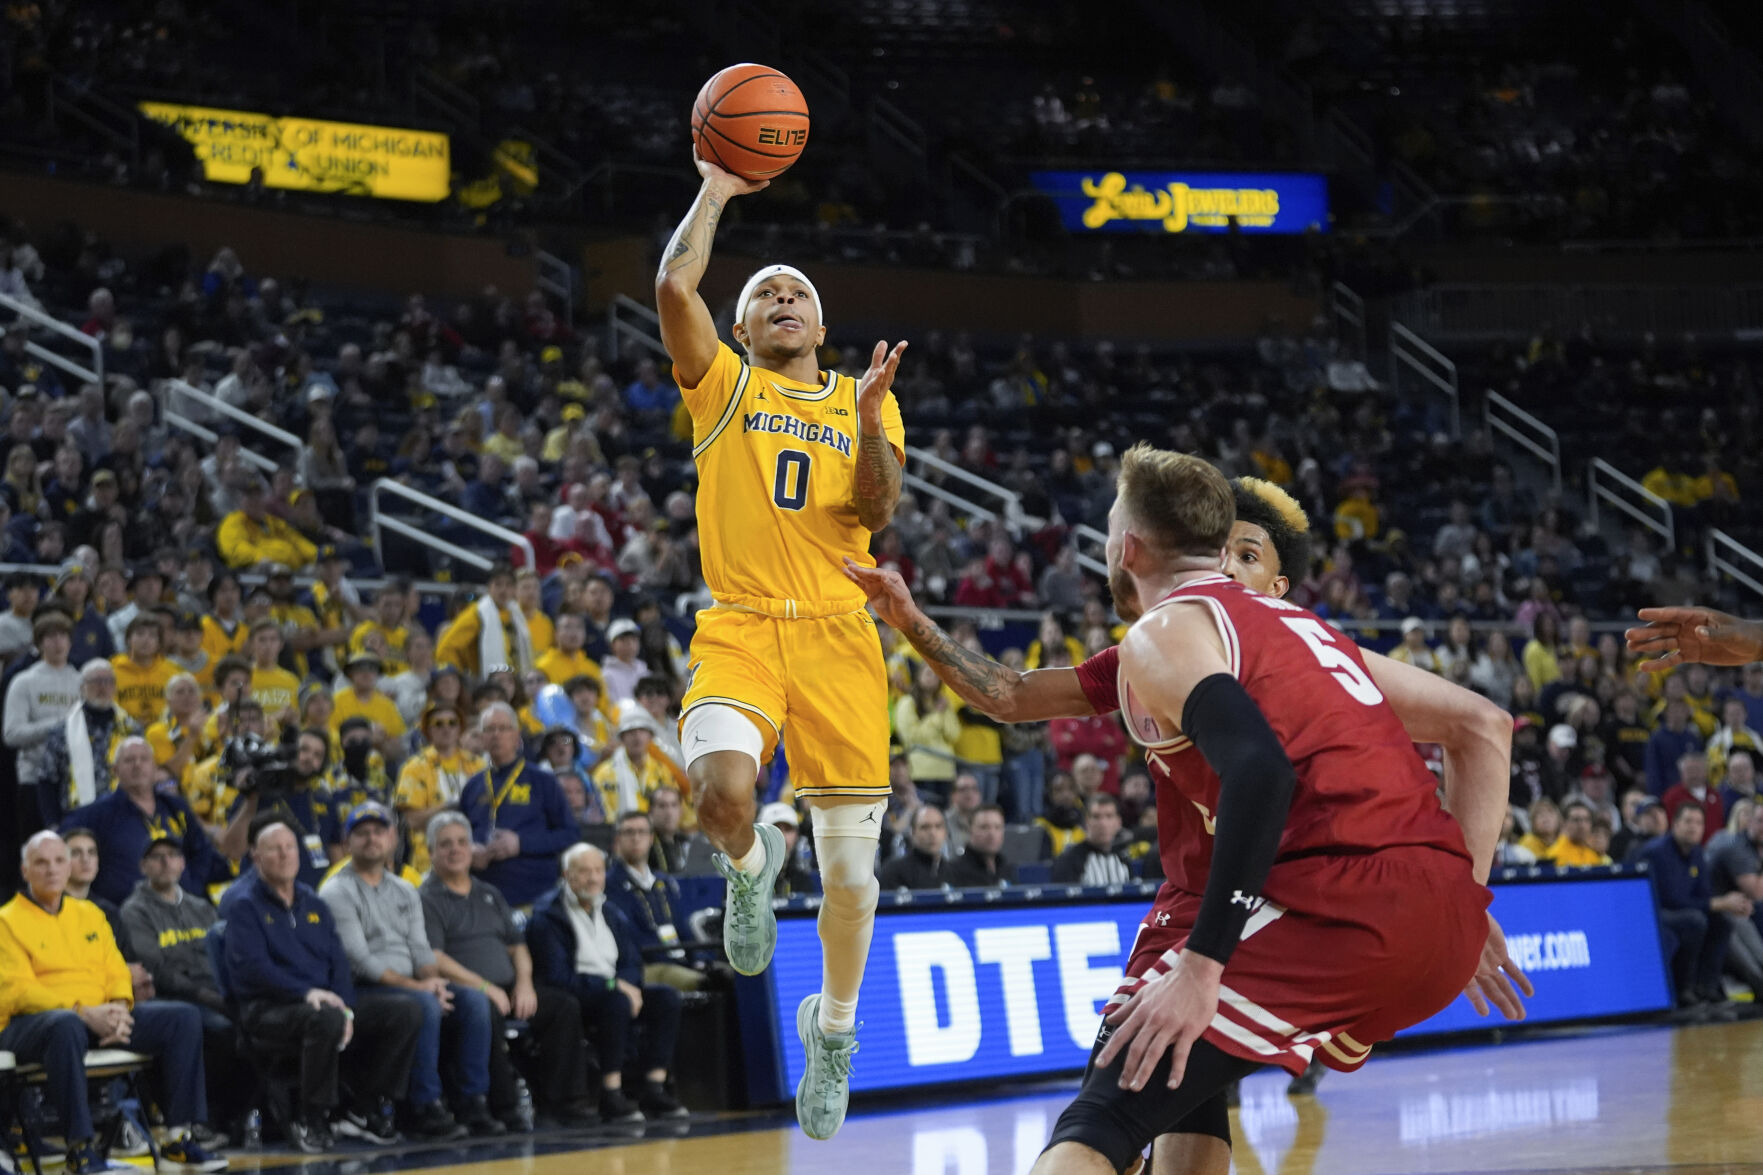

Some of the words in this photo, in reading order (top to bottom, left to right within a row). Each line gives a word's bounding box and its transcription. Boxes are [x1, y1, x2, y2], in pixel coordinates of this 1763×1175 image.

[333, 130, 446, 160] MICHIGAN
[758, 127, 807, 146] ELITE
[314, 153, 391, 177] UNION
[743, 411, 852, 458] MICHIGAN
[773, 449, 811, 511] 0
[1279, 617, 1383, 706] 5
[1504, 930, 1590, 971] wer.com
[893, 921, 1123, 1067] DTE
